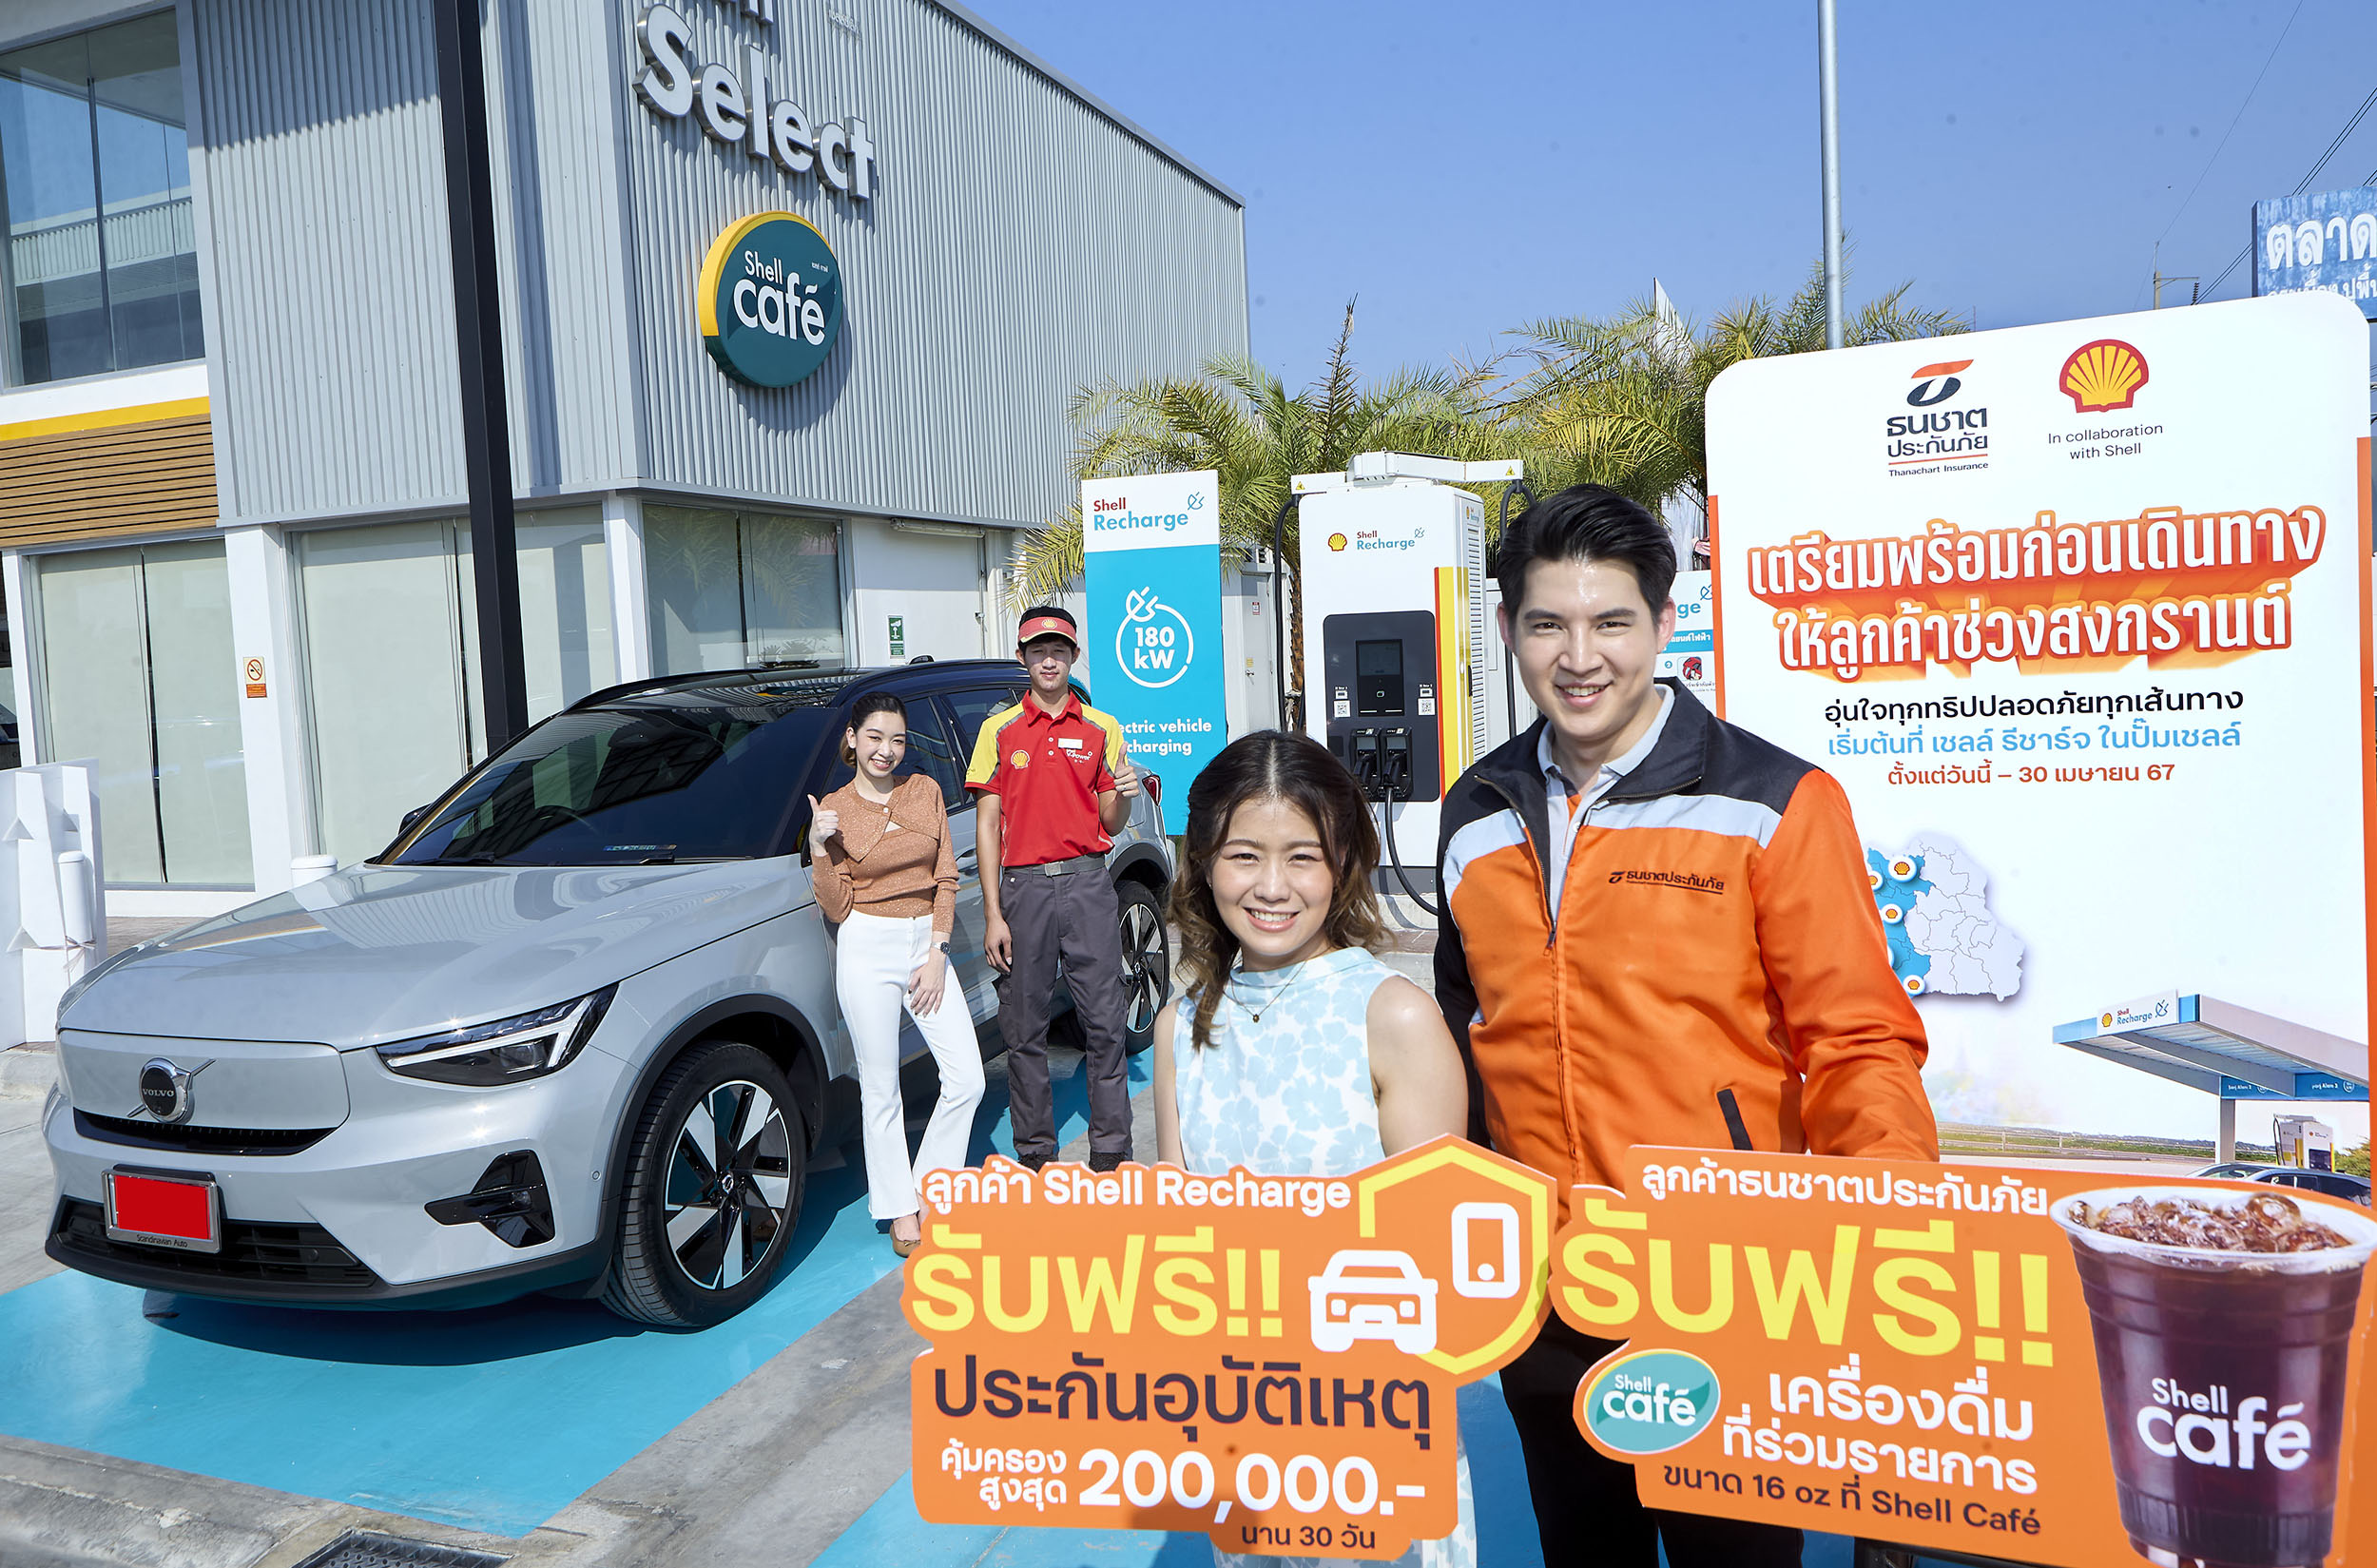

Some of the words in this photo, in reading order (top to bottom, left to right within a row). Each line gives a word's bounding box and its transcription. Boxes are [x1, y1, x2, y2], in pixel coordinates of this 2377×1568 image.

[633, 4, 875, 200] Select
[744, 250, 783, 285] Shell
[733, 272, 825, 345] café
[1886, 407, 1988, 437] ธนชาต
[2048, 433, 2061, 444] In
[2065, 423, 2164, 443] collaboration
[1887, 432, 1989, 457] ประกันภัย
[2070, 447, 2100, 460] with
[2104, 443, 2142, 456] Shell
[1889, 466, 1941, 477] Thanachart
[1943, 462, 1989, 473] Insurance
[1093, 497, 1127, 512] Shell
[1093, 511, 1188, 532] Recharge
[1357, 531, 1378, 539] Shell
[1357, 538, 1416, 551] Recharge
[1750, 509, 2324, 595] เตรียมพร้อมก่อนเดินทาง
[1134, 626, 1175, 648] 180
[1779, 581, 2288, 679] ให้ลูกค้าช่วงสงกรานต์
[1134, 648, 1175, 669] kW
[1824, 686, 2244, 728] อุ่นใจทุกทริปปลอดภัยทุกเส้นทาง
[1118, 720, 1156, 733] ectric
[1158, 718, 1212, 733] vehicle
[1828, 725, 1923, 755] เริ่มต้นที่
[1932, 728, 1994, 753] เชลล์
[2001, 725, 2091, 752] รีชาร์จ
[2098, 718, 2242, 749] ในปั๊มเชลล์
[1127, 740, 1192, 756] charging
[1887, 759, 1992, 784] ตั้งแต่วันนี้
[2019, 765, 2048, 783] 30
[2055, 764, 2140, 783] เมษายน
[2147, 764, 2175, 781] 67
[1626, 870, 1725, 891] ธนชาตประกันภัย
[2116, 1013, 2153, 1025] Recharge
[143, 1089, 174, 1097] VOLVO
[925, 1159, 1033, 1215] ลูกค้า
[1045, 1169, 1143, 1206] Shell
[1156, 1169, 1352, 1217] Recharge
[1642, 1156, 2049, 1216] ลูกค้าธนชาตประกันภัย
[911, 1223, 1284, 1338] รับฟรี!!
[1561, 1197, 2054, 1368] รับฟรี!!
[935, 1351, 1431, 1450] ประกันอุบัติเหตุ
[1614, 1374, 1652, 1393] Shell
[1768, 1352, 2034, 1442] เครื่องดื่ม
[2152, 1377, 2229, 1414] Shell
[1602, 1383, 1696, 1427] café
[1723, 1403, 2038, 1495] ที่ร่วมรายการ
[2136, 1396, 2311, 1471] café
[940, 1437, 1068, 1481] คุ้มครอง
[978, 1475, 1068, 1512] สูงสุด
[1078, 1448, 1426, 1524] 200,000.-
[1663, 1464, 1743, 1495] ขนาด
[1752, 1473, 1786, 1500] 16
[1795, 1484, 1831, 1507] oz
[1840, 1474, 1862, 1511] ที่
[1871, 1488, 1952, 1523] Shell
[1962, 1500, 2041, 1536] Café
[1241, 1523, 1292, 1547] นาน
[1299, 1526, 1333, 1547] 30
[1341, 1521, 1377, 1550] วัน
